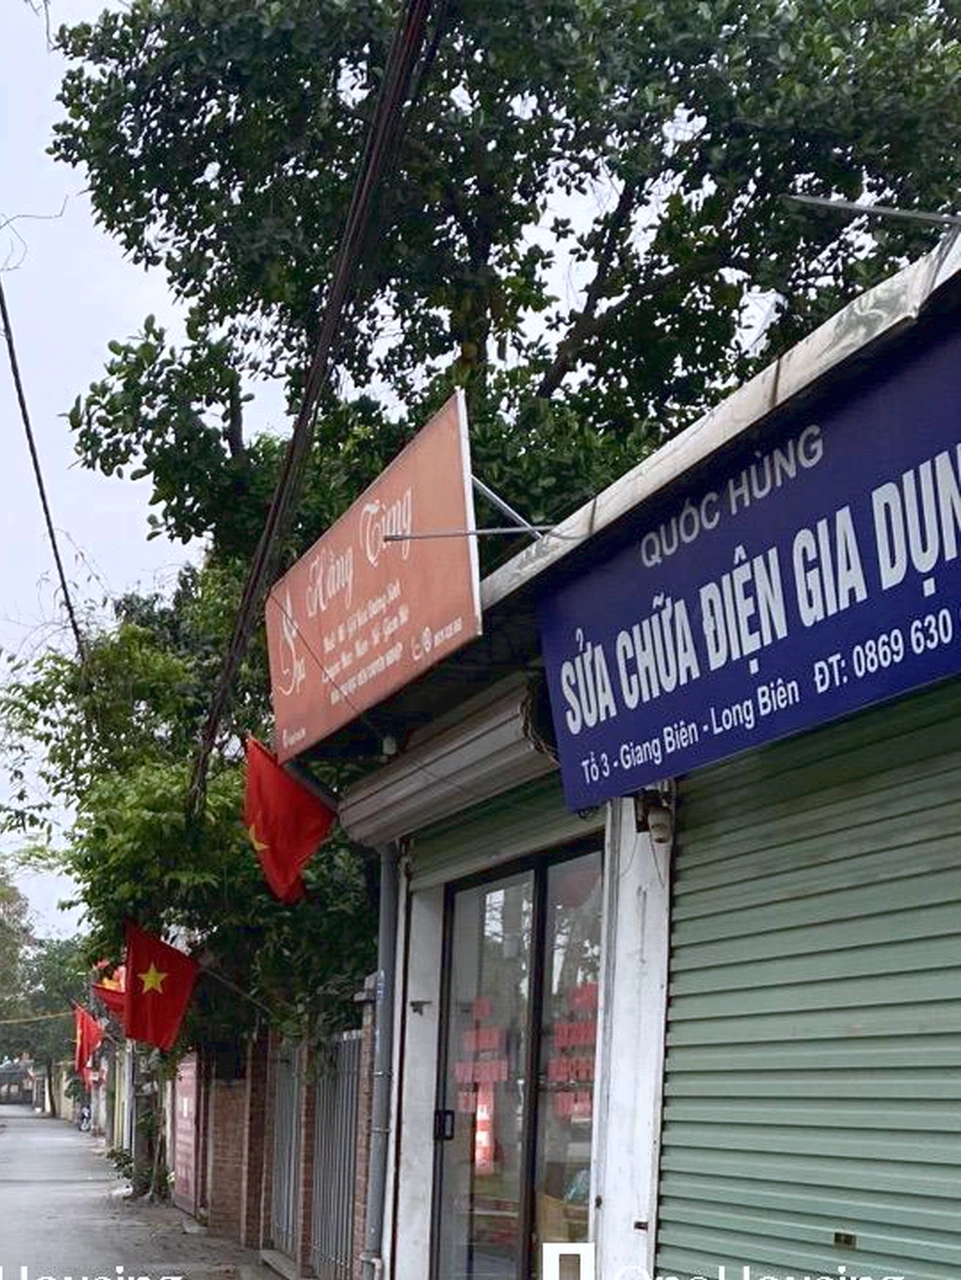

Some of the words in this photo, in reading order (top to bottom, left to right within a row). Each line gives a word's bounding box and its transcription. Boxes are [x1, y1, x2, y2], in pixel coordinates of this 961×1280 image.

[728, 424, 823, 515] HÙNG
[561, 628, 617, 735] SỬA
[616, 592, 700, 709] CHỮA
[700, 545, 788, 674] ĐIỆN
[792, 505, 867, 627] GIA
[581, 751, 599, 783] Tổ
[602, 753, 610, 777] 3
[620, 735, 661, 770] Giang
[663, 720, 699, 753] Biên
[709, 698, 754, 734] Long
[757, 677, 799, 716] Biên
[814, 653, 848, 693] ĐT:
[853, 628, 904, 678] 0869
[911, 608, 952, 654] 630
